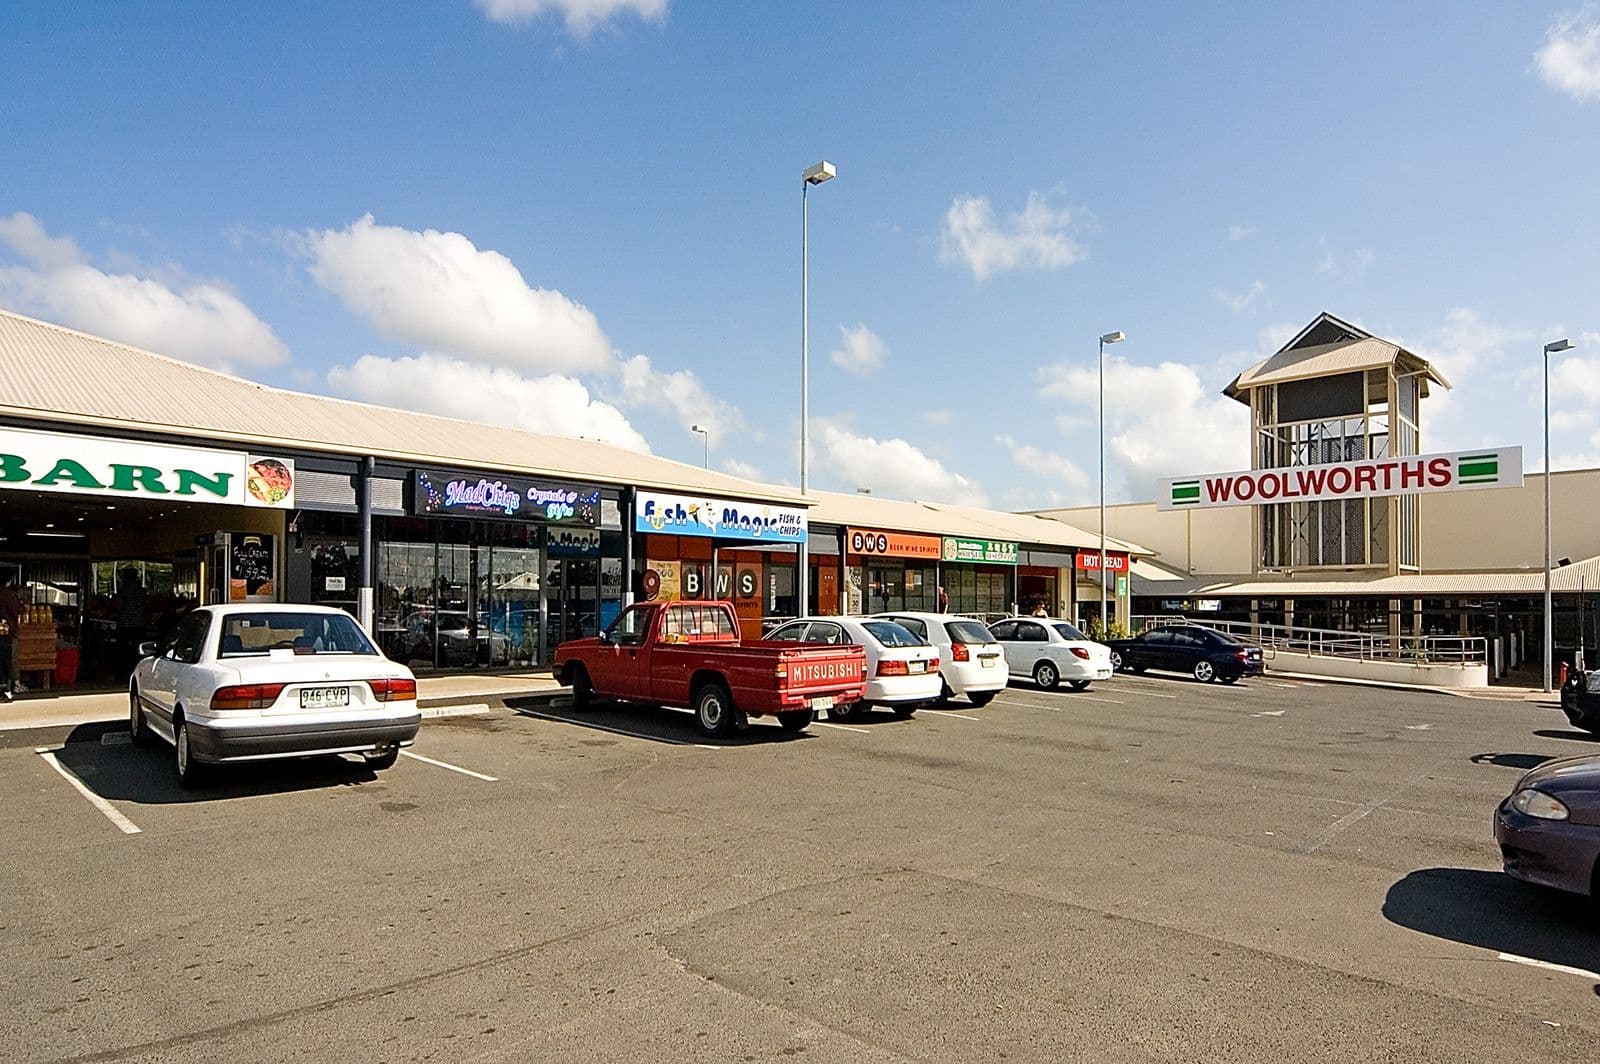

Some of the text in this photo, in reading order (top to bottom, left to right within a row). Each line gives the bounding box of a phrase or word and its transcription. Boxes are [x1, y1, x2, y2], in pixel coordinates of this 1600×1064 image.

[0, 454, 234, 497] BARN
[1206, 459, 1452, 502] WOOLWORTHS
[722, 508, 778, 536] Magic
[779, 513, 801, 525] FISH &
[779, 525, 801, 536] CHIPS
[560, 532, 600, 551] Magic
[855, 535, 885, 550] BWS
[1084, 555, 1099, 567] HOT
[794, 662, 857, 681] MITSUBISHI
